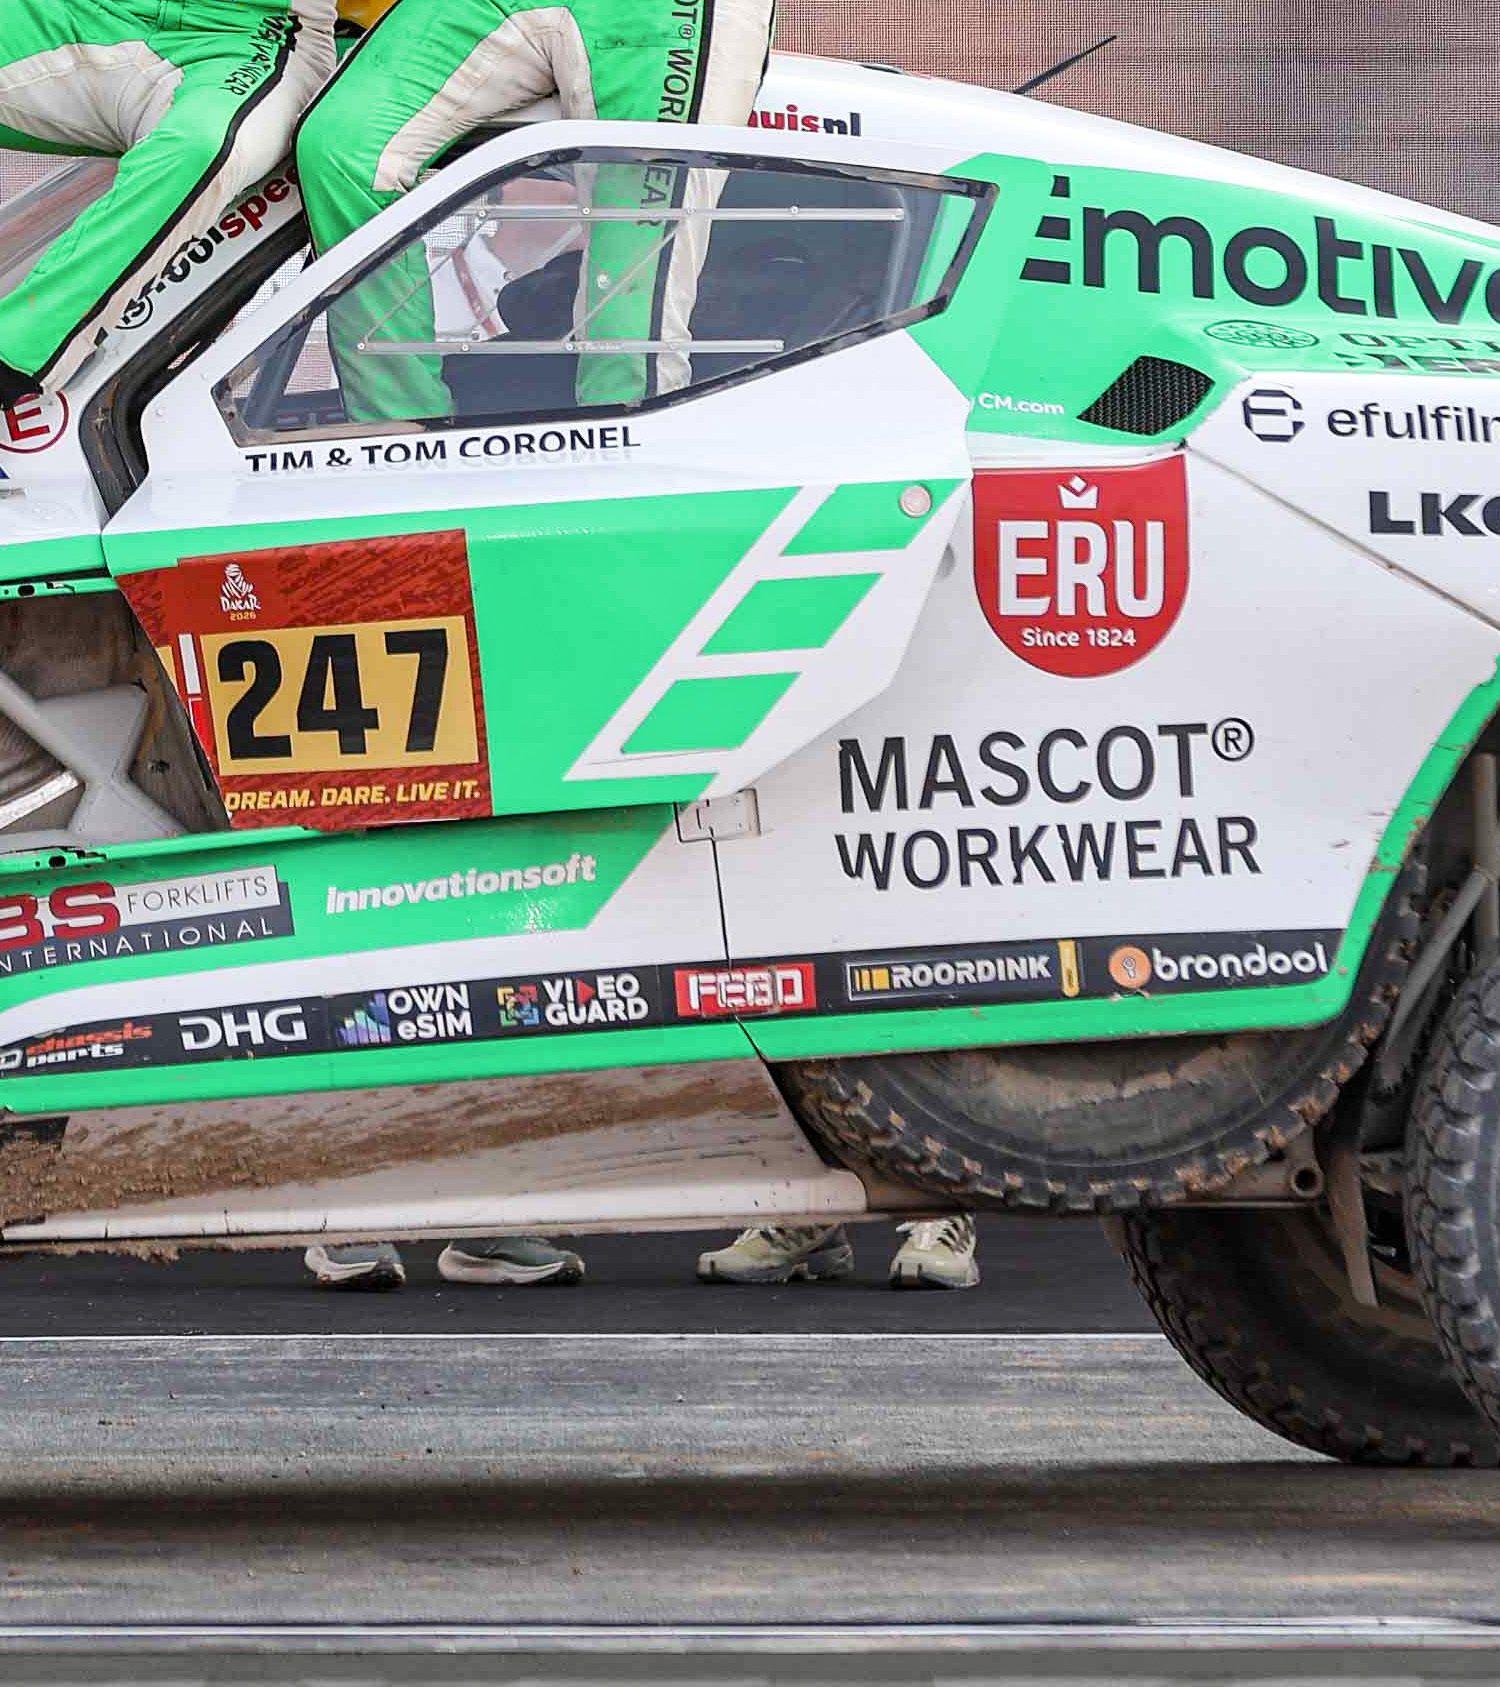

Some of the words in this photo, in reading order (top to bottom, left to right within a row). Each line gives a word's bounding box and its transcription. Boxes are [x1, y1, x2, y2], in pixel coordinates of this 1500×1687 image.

[977, 392, 1065, 418] CM.com
[244, 448, 315, 473] TIM
[325, 447, 353, 468] &
[358, 439, 449, 465] TOM
[458, 424, 642, 461] CORONEL
[999, 518, 1167, 620] ERU
[220, 595, 262, 613] DAKAR
[229, 611, 257, 622] 2026
[1021, 627, 1081, 649] Since
[1086, 627, 1137, 649] 1824
[217, 628, 449, 761] 247
[224, 787, 316, 812] DREAM.
[320, 784, 392, 809] DARE.
[396, 781, 448, 804] LIVE
[452, 778, 481, 801] IT.
[834, 815, 1263, 892] WORKWEAR
[126, 876, 269, 914] FORKLIFTS
[326, 852, 597, 914] innovationsoft
[891, 955, 1052, 989] ROORDINK
[1153, 941, 1330, 983] brondool
[388, 984, 471, 1015] OWN
[688, 970, 805, 1010] FEBO
[179, 1004, 308, 1052] DHG
[397, 1011, 474, 1041] eSIM
[545, 997, 649, 1028] GUARD
[25, 1042, 125, 1070] parts
